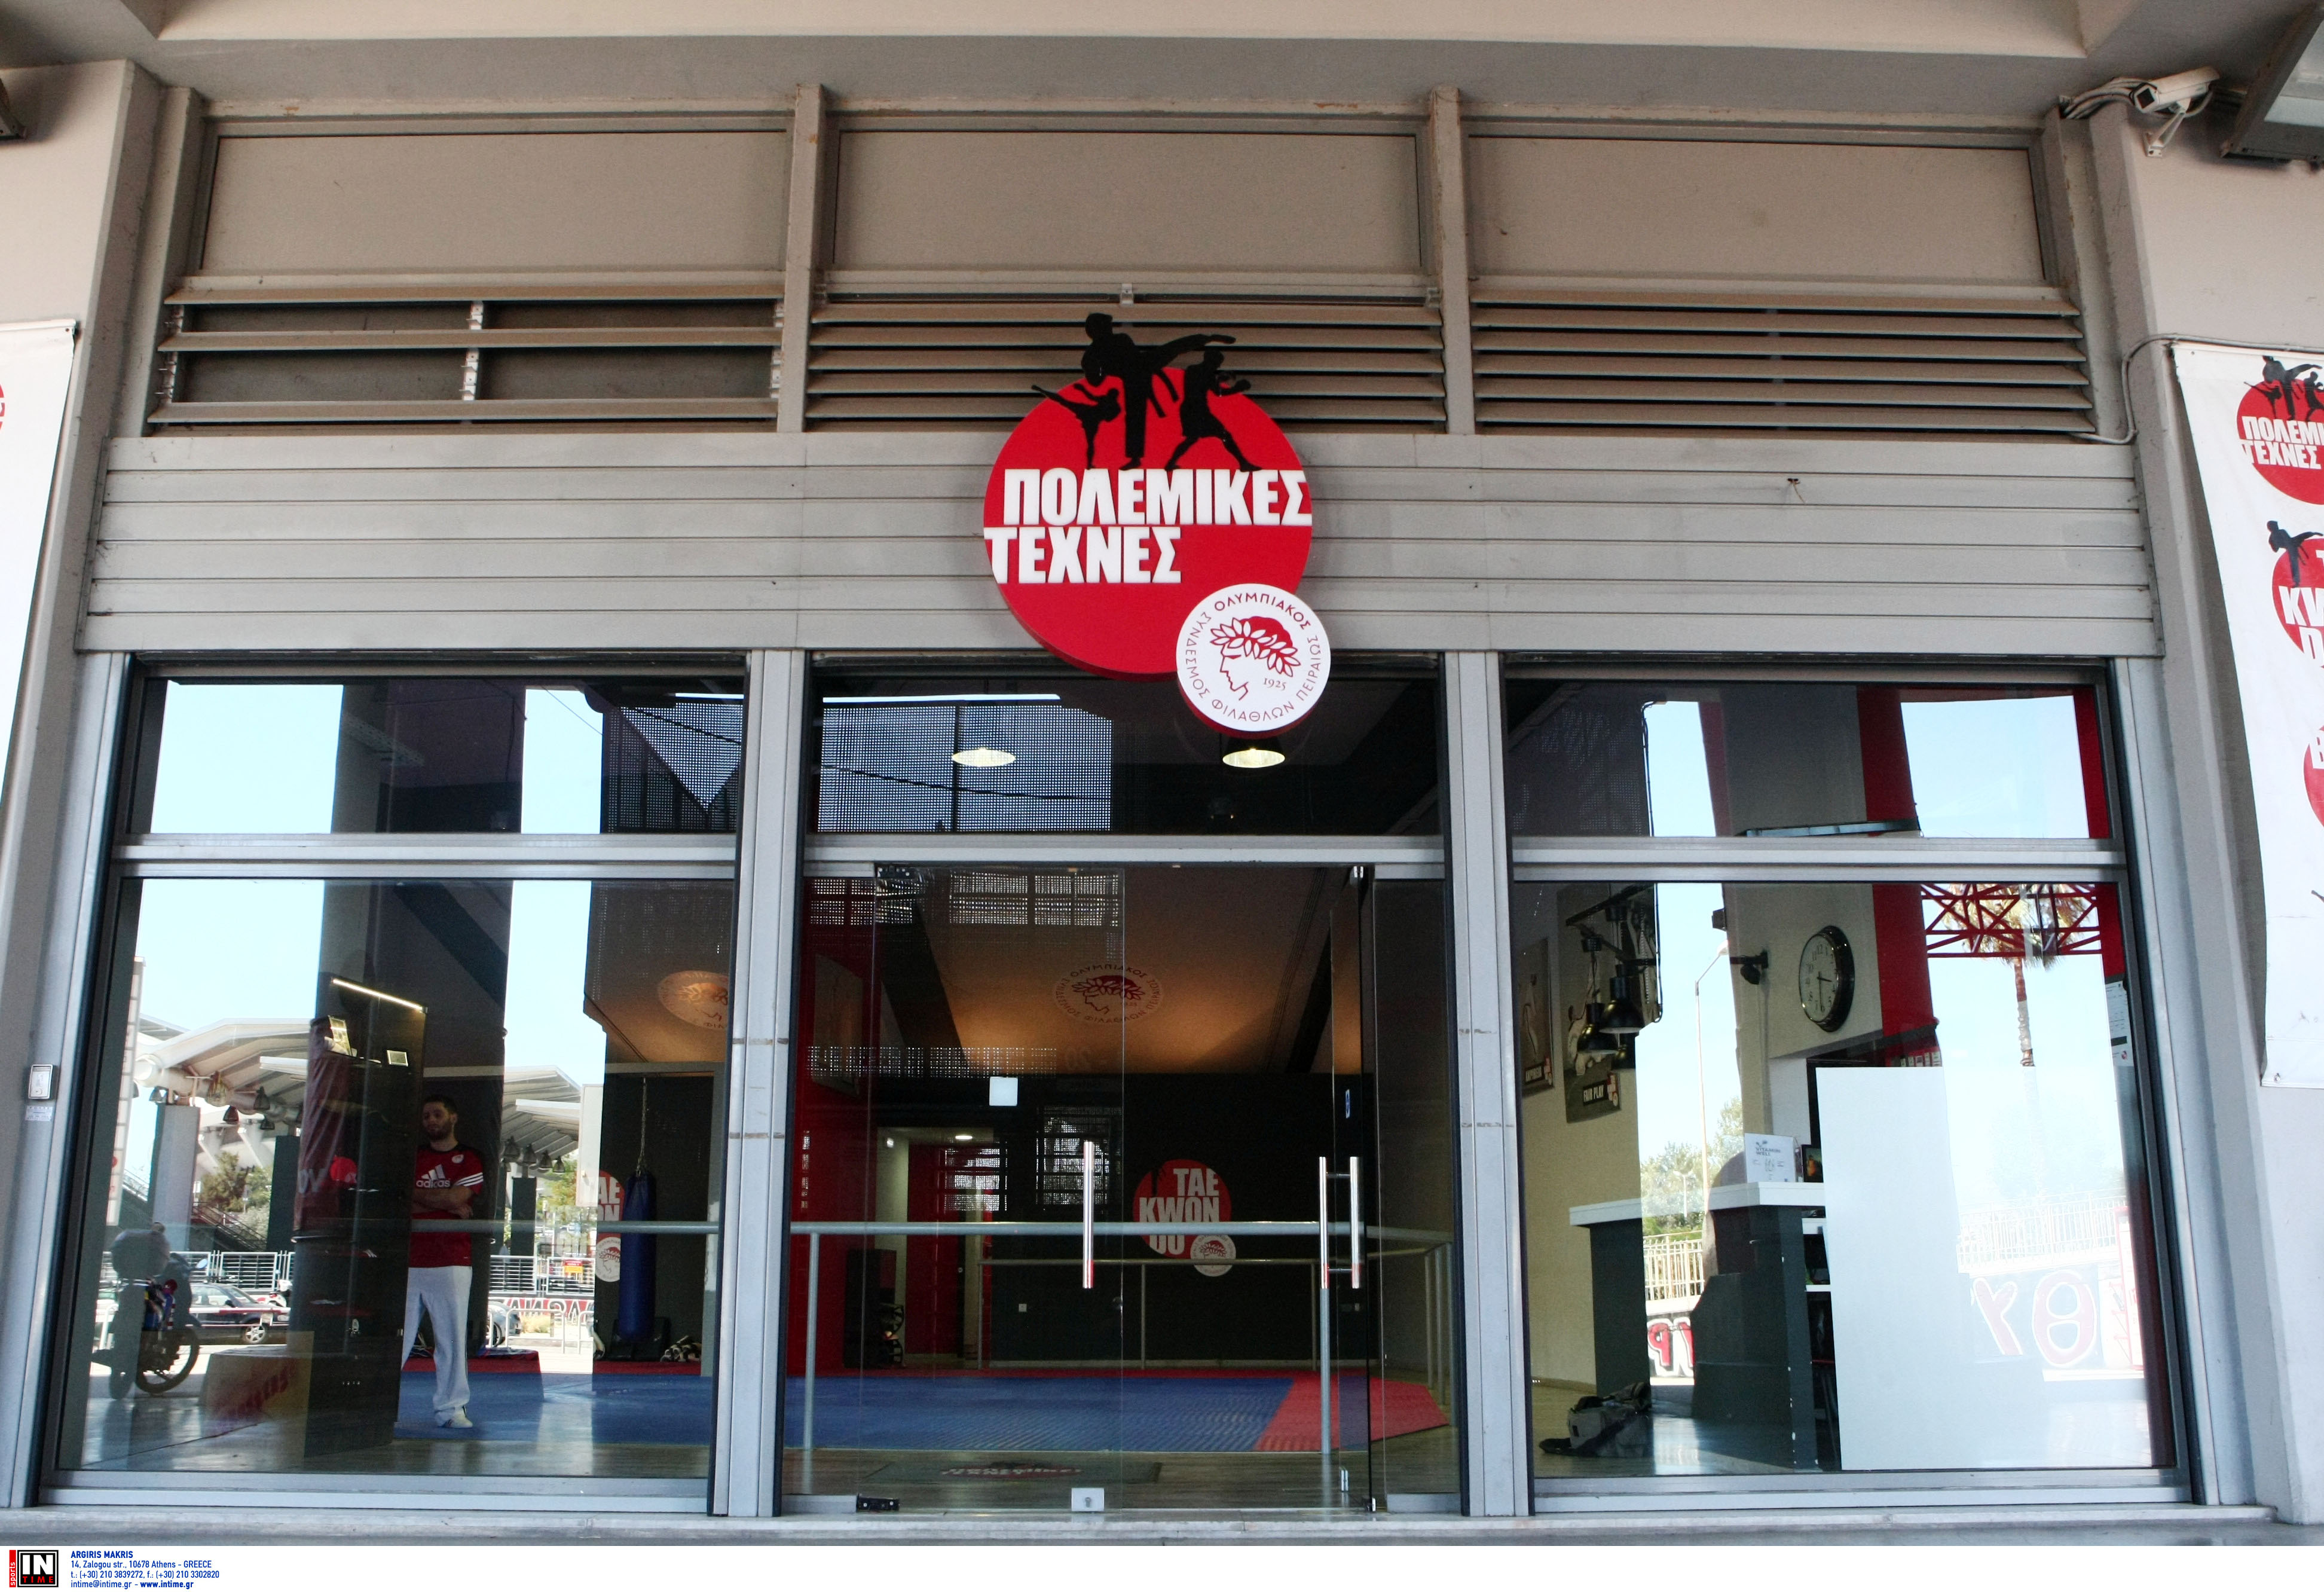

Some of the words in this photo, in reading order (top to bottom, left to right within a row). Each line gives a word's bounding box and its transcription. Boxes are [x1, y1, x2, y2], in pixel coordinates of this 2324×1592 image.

[2242, 440, 2321, 470] ΤΕΧΝΕΣ
[1003, 467, 1312, 526] ΠΟΛΕΜΙΚΕΣ
[984, 527, 1181, 583] ΤΕΧΝΕΣ
[1215, 592, 1310, 630] ΟΛΥΜΠΙΑΚΟΣ
[1185, 612, 1212, 698] ΣΥΝΔΕΣΜΟΣ
[1212, 701, 1294, 722] ΦΙΛΑΘΛΩΝ
[1296, 635, 1321, 701] ΠΕΙΡΑΙΩΣ
[1263, 677, 1287, 690] 1925
[1593, 1084, 1604, 1099] PLAY
[598, 1177, 620, 1205] AE
[1173, 1168, 1219, 1196] TAE
[1139, 1197, 1220, 1223] KWON
